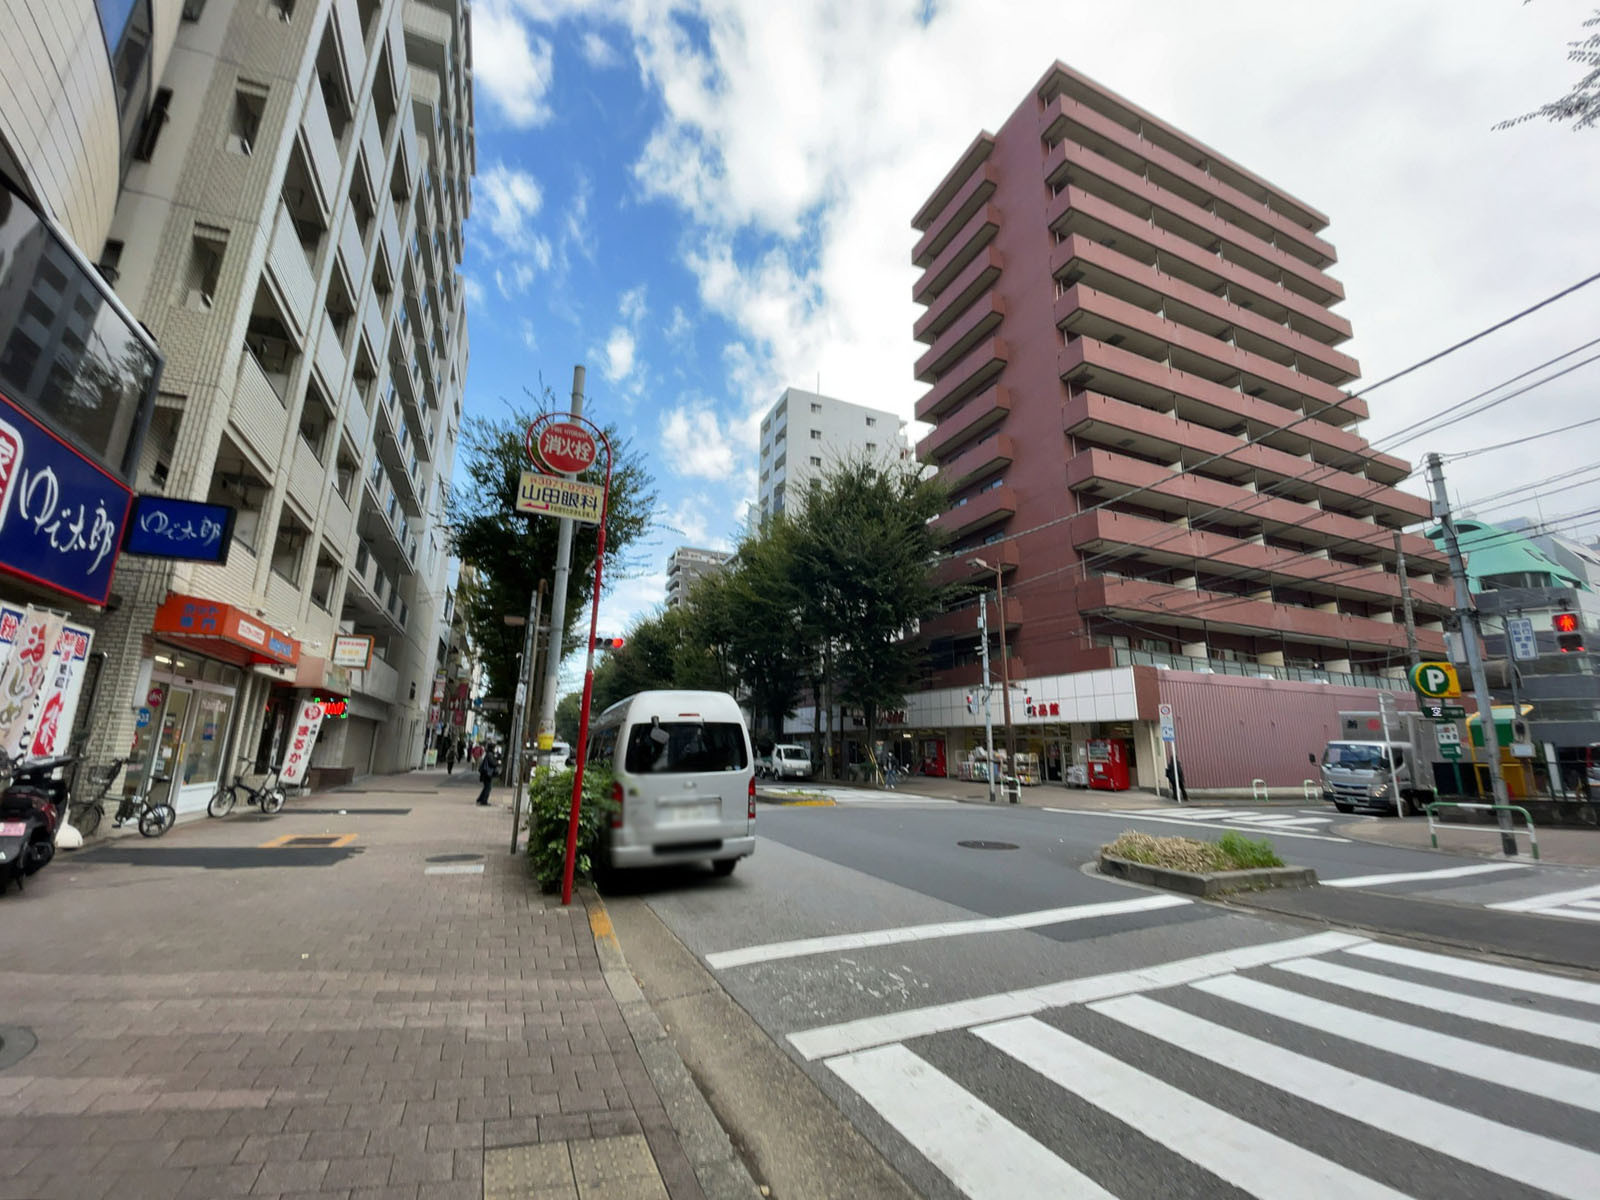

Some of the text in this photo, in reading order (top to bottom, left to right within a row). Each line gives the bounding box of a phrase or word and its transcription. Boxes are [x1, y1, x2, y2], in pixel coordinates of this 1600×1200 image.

[543, 433, 592, 463] 消火栓
[522, 484, 597, 511] 山田眼科
[20, 465, 115, 575] ゆで太郎
[141, 510, 221, 546] ゆで太郎
[1426, 669, 1445, 692] P
